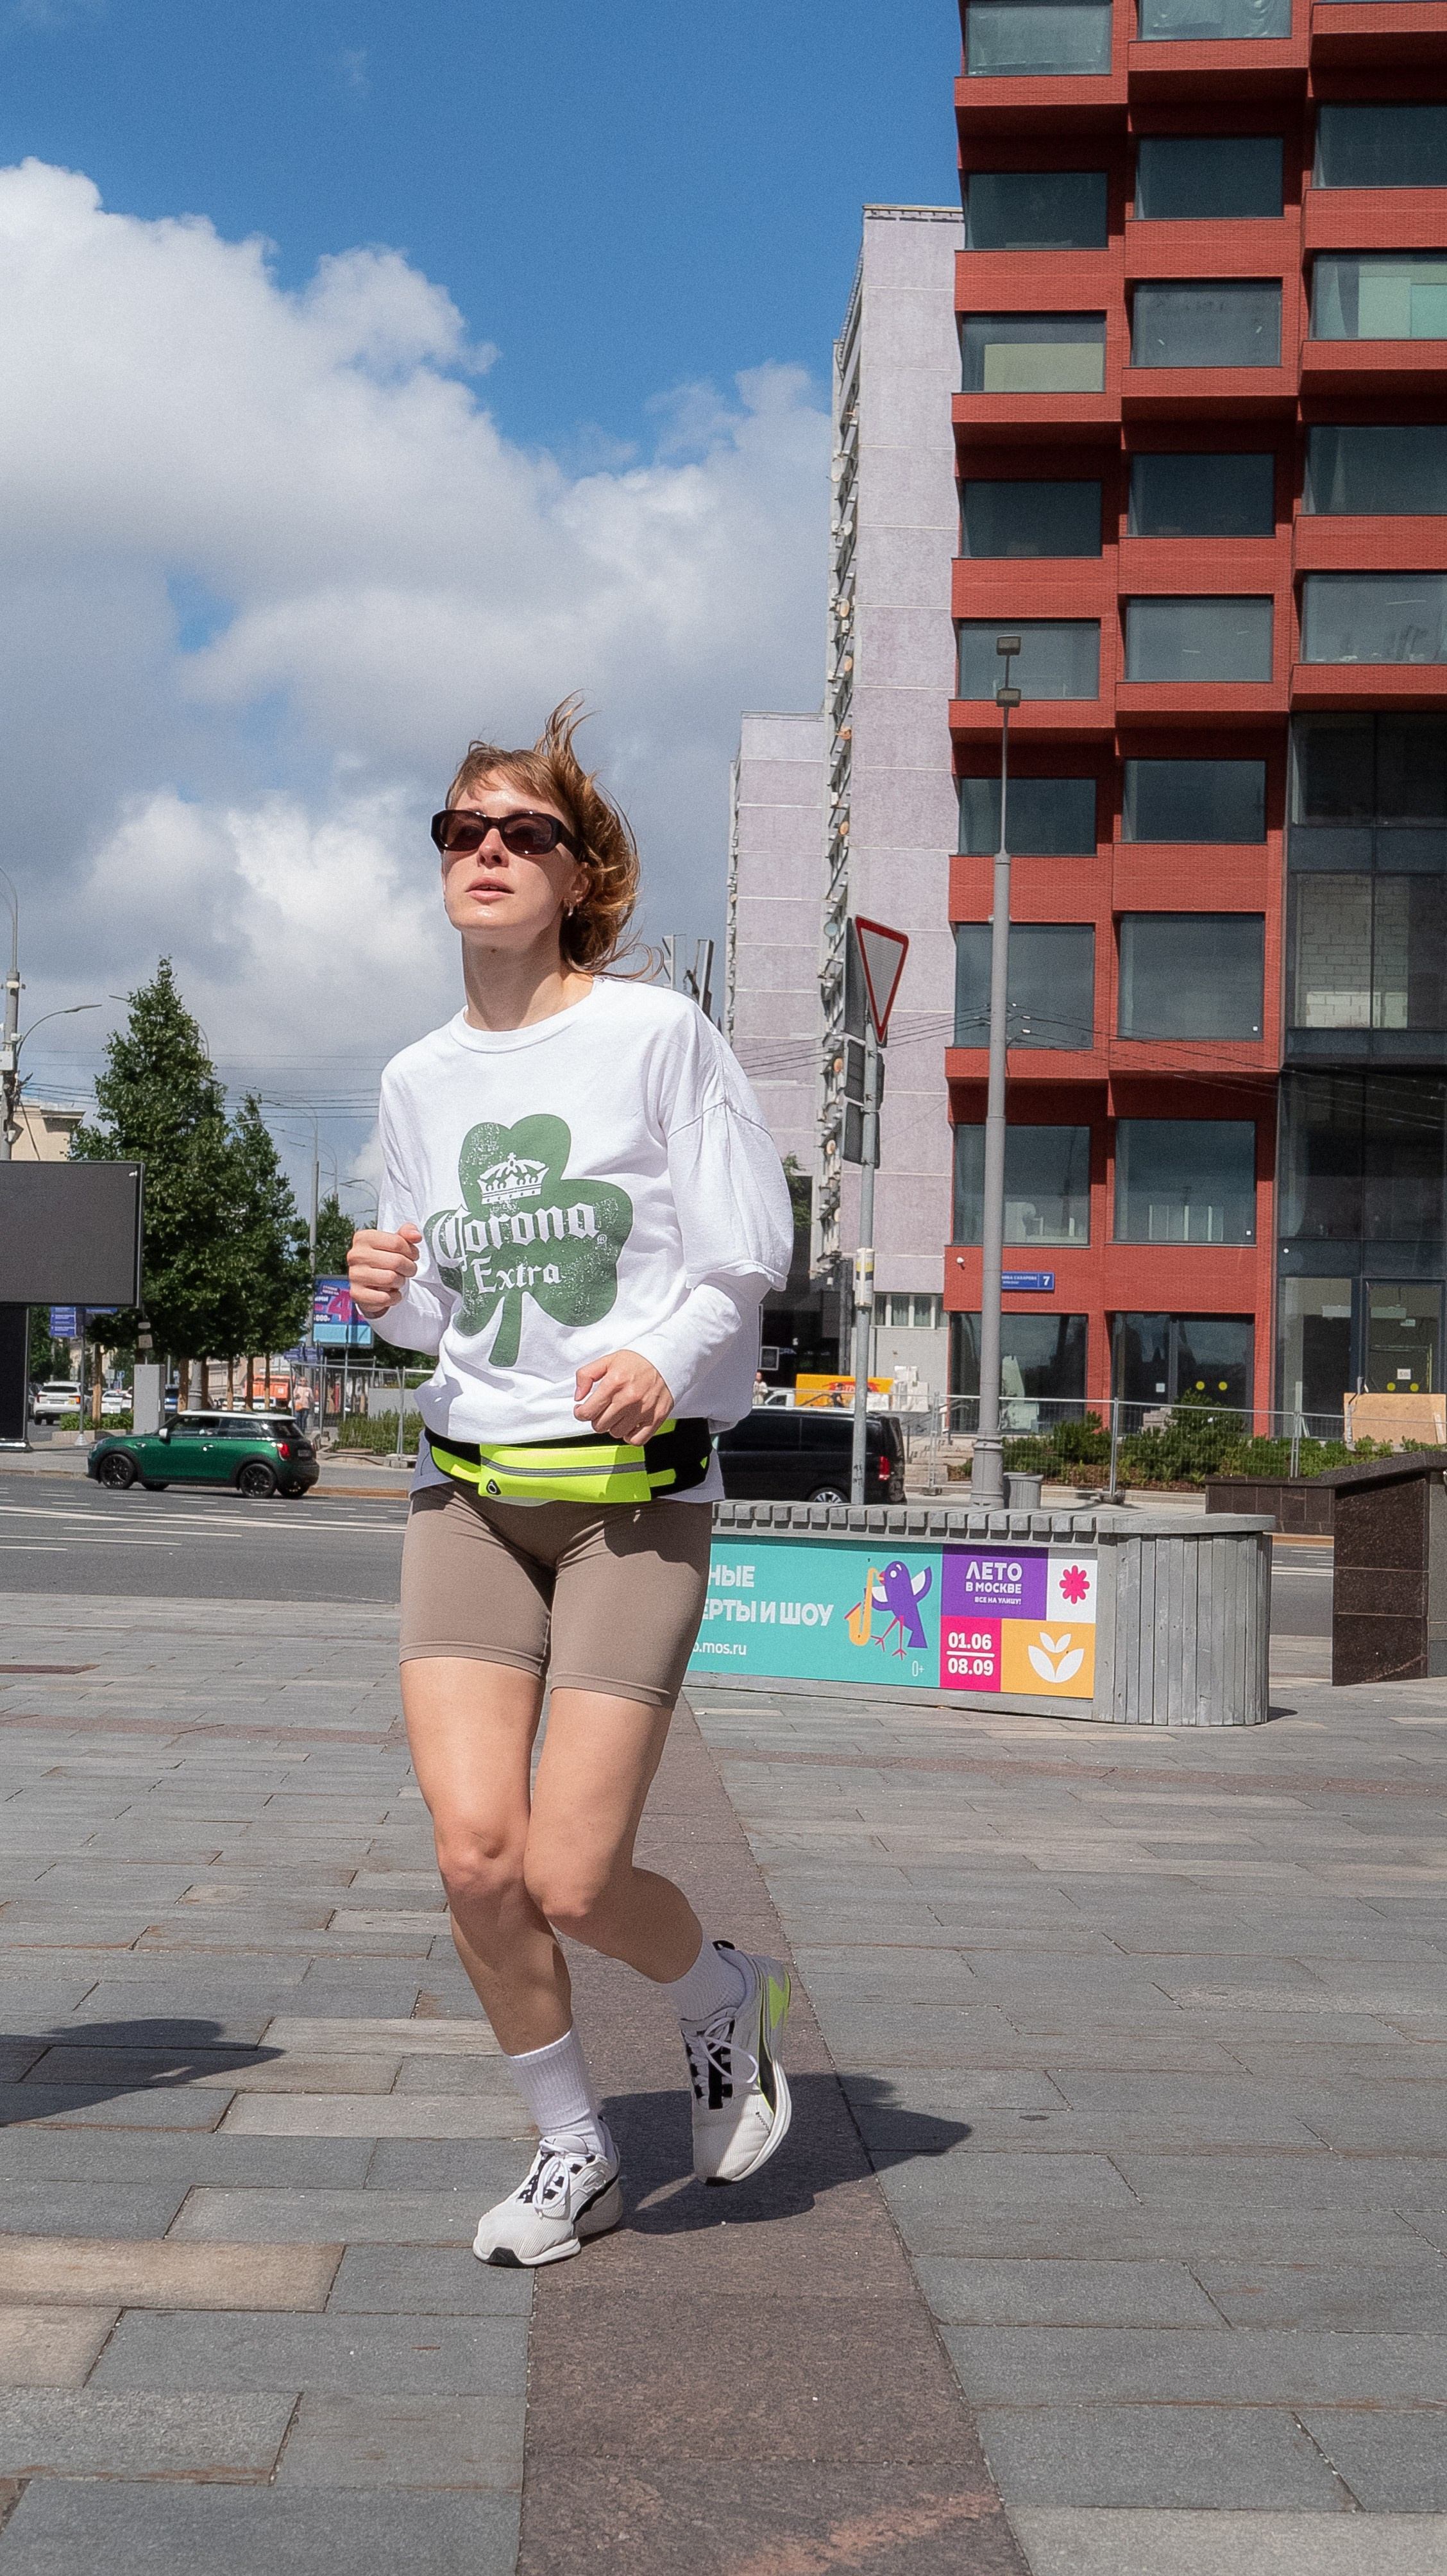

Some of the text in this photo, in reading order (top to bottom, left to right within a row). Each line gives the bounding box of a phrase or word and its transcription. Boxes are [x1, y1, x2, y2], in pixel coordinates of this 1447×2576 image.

[432, 1202, 599, 1271] Corona
[471, 1257, 562, 1294] Extra
[1043, 1276, 1050, 1285] 7
[966, 1561, 1022, 1582] ЛЕТО
[965, 1582, 1022, 1594] В МОСКВЕ
[760, 1601, 776, 1623] И
[779, 1602, 834, 1626] ШОУ
[948, 1632, 992, 1650] 01.06
[912, 1661, 925, 1677] 0+
[948, 1657, 994, 1676] 08.09
